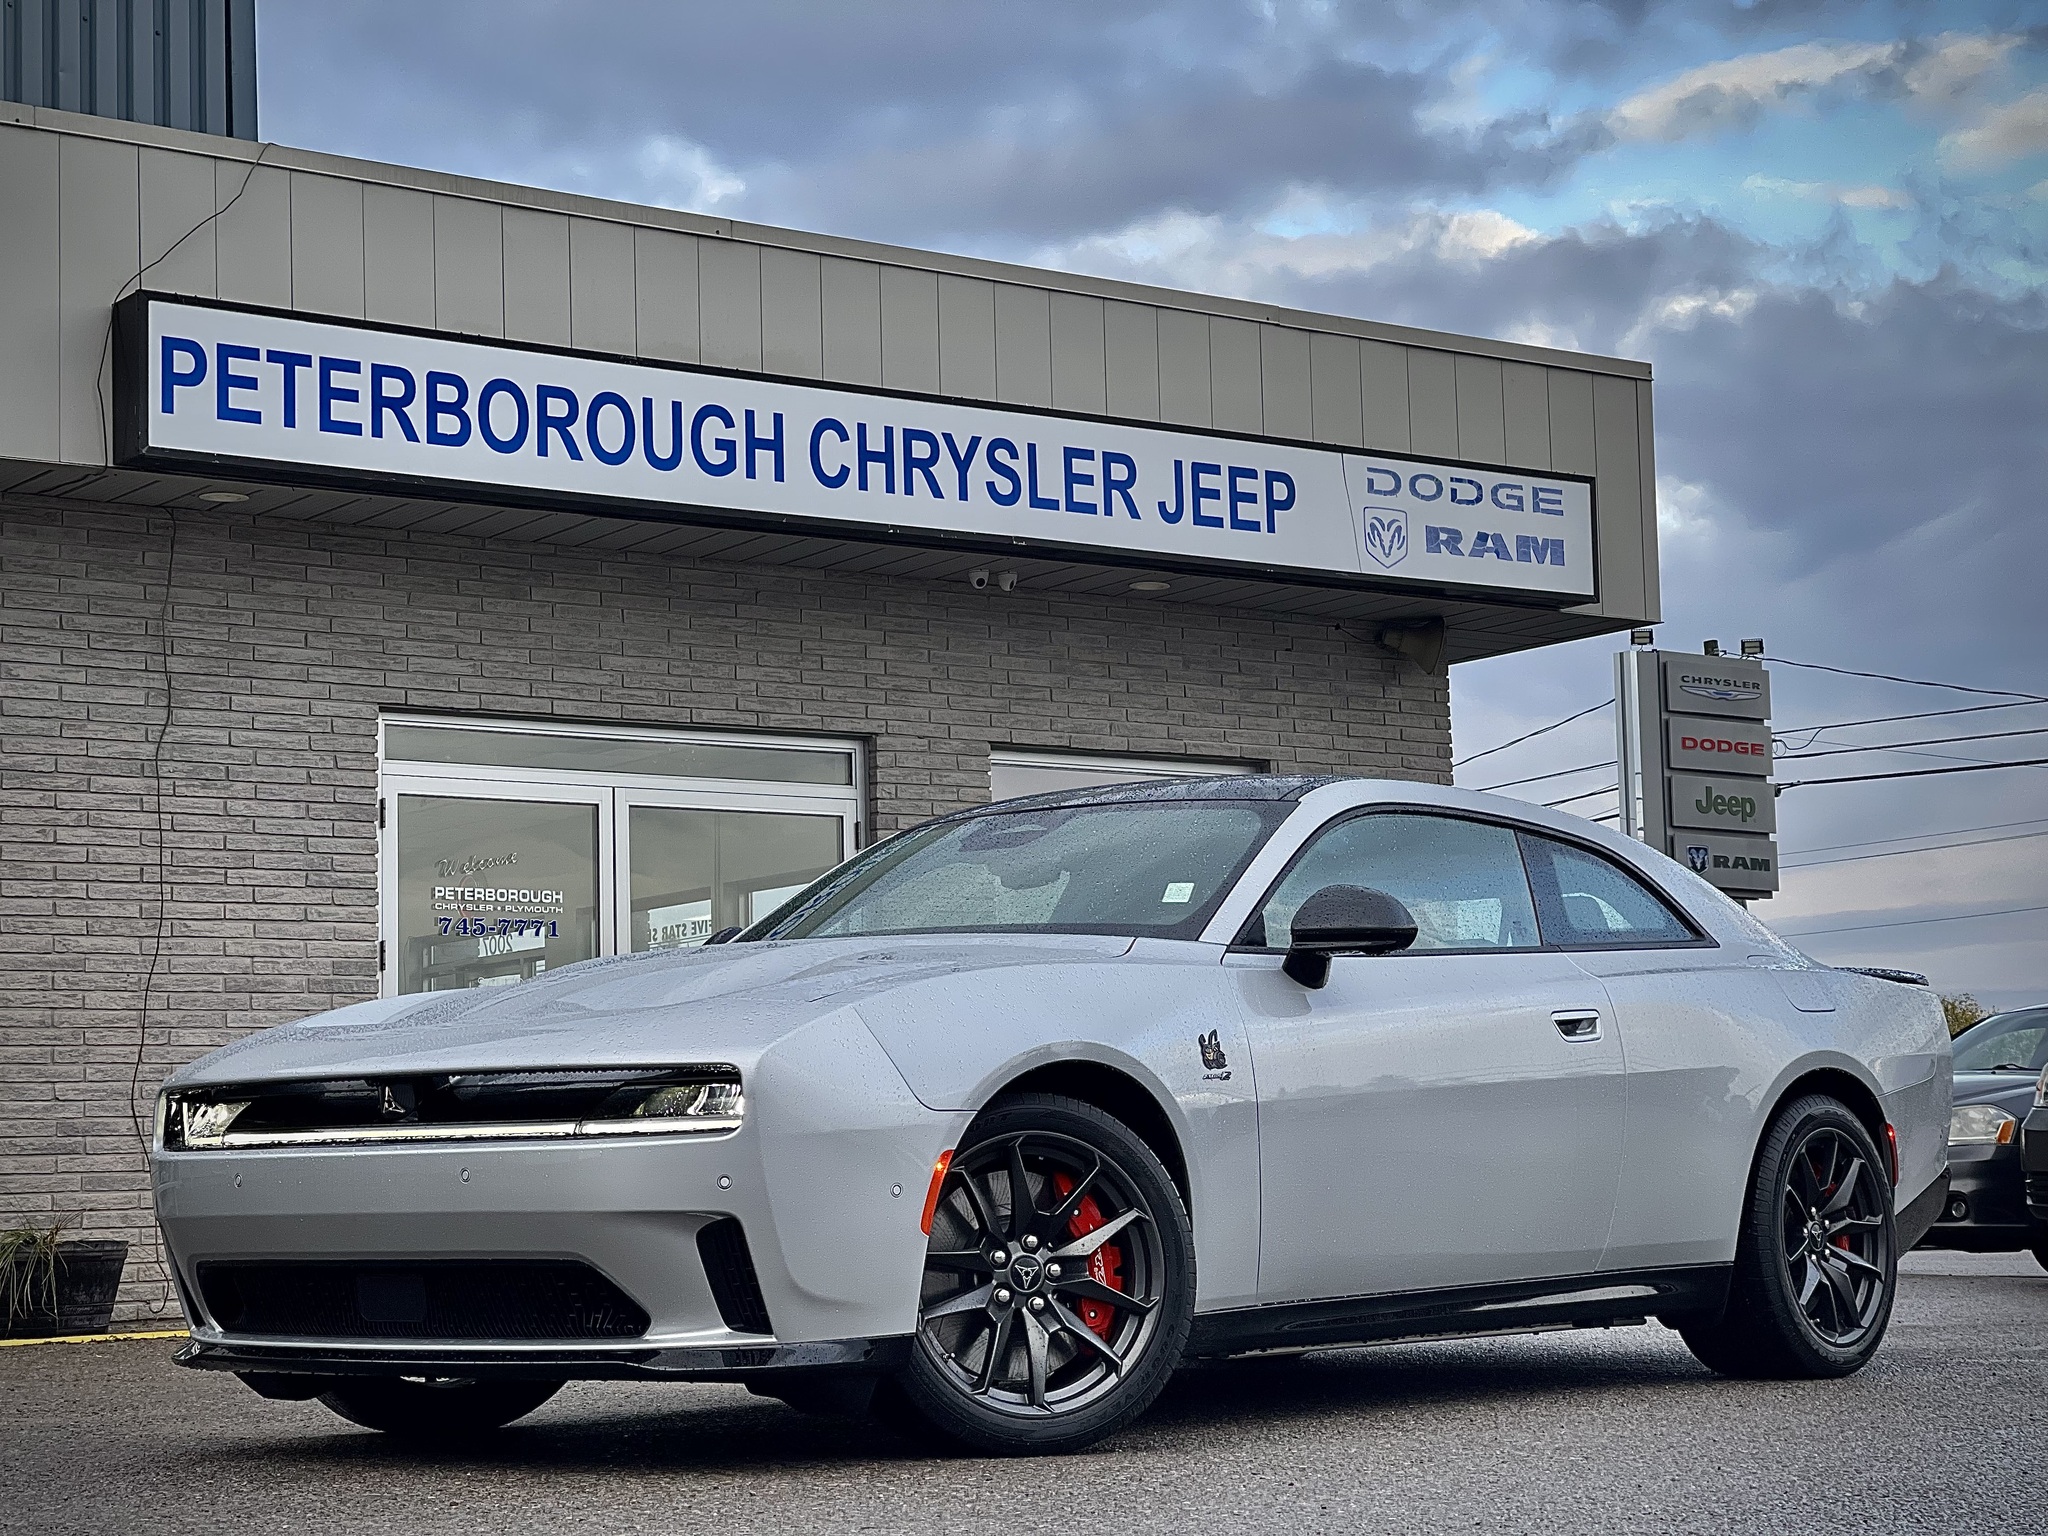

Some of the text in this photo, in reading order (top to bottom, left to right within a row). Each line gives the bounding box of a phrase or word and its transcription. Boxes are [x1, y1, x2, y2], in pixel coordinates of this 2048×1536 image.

[160, 335, 1297, 534] PETERBOROUGH CHRYSLER JEEP
[1366, 466, 1564, 517] DODGE
[1424, 524, 1566, 567] RAM
[1680, 674, 1761, 690] CHRYSLER
[1681, 736, 1765, 756] DODGE
[1695, 785, 1756, 822] Jeep
[435, 852, 518, 877] Welcome
[1712, 854, 1771, 872] RAM
[434, 886, 563, 904] PETERBOROUGH
[434, 902, 563, 914] CHRYSLER PLYMOUTH
[438, 916, 559, 938] 745-7771
